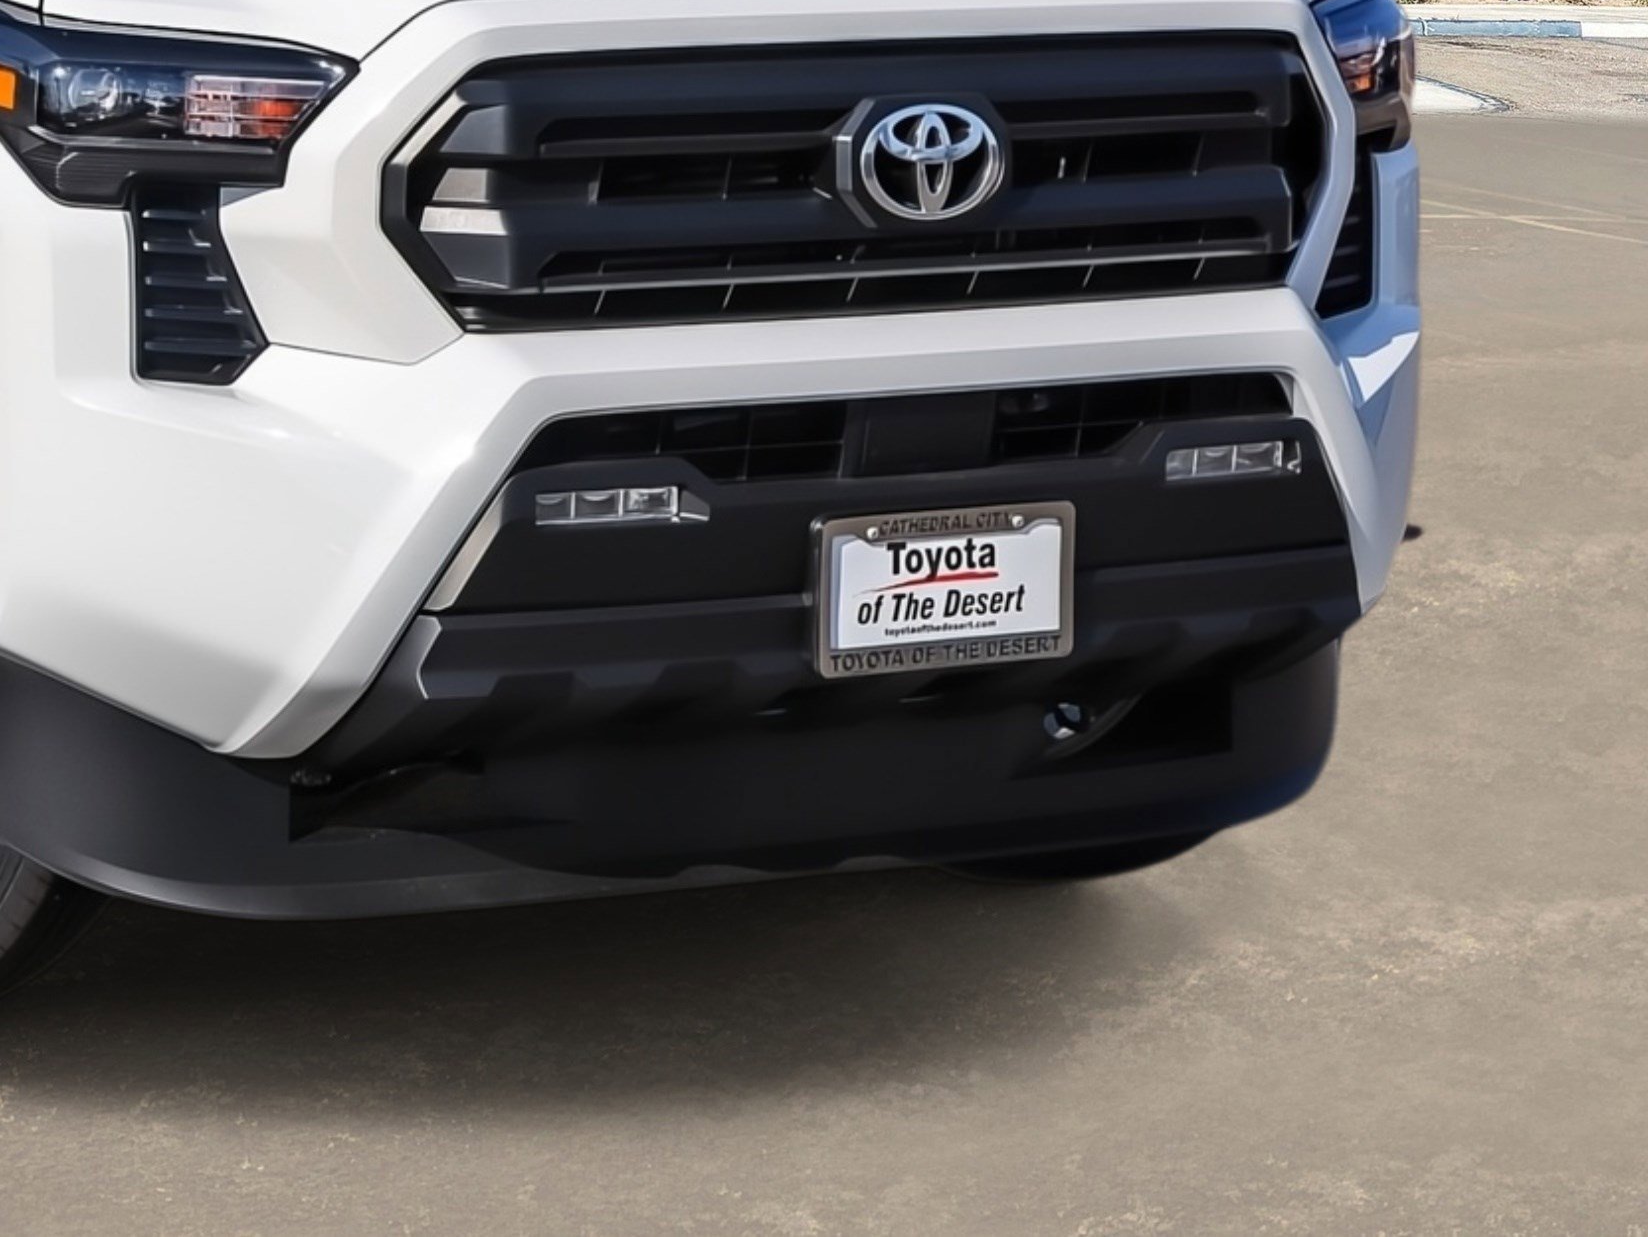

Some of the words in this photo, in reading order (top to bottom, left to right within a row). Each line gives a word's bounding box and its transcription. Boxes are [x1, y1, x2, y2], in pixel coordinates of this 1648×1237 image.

[879, 514, 972, 536] CATHEDRAL
[887, 538, 997, 581] Toyota
[858, 594, 884, 625] of
[891, 592, 935, 622] The
[943, 584, 1026, 618] Desert
[831, 649, 904, 673] TOYOTA
[912, 647, 937, 664] OF
[943, 642, 981, 661] THE
[986, 634, 1062, 658] DESERT
